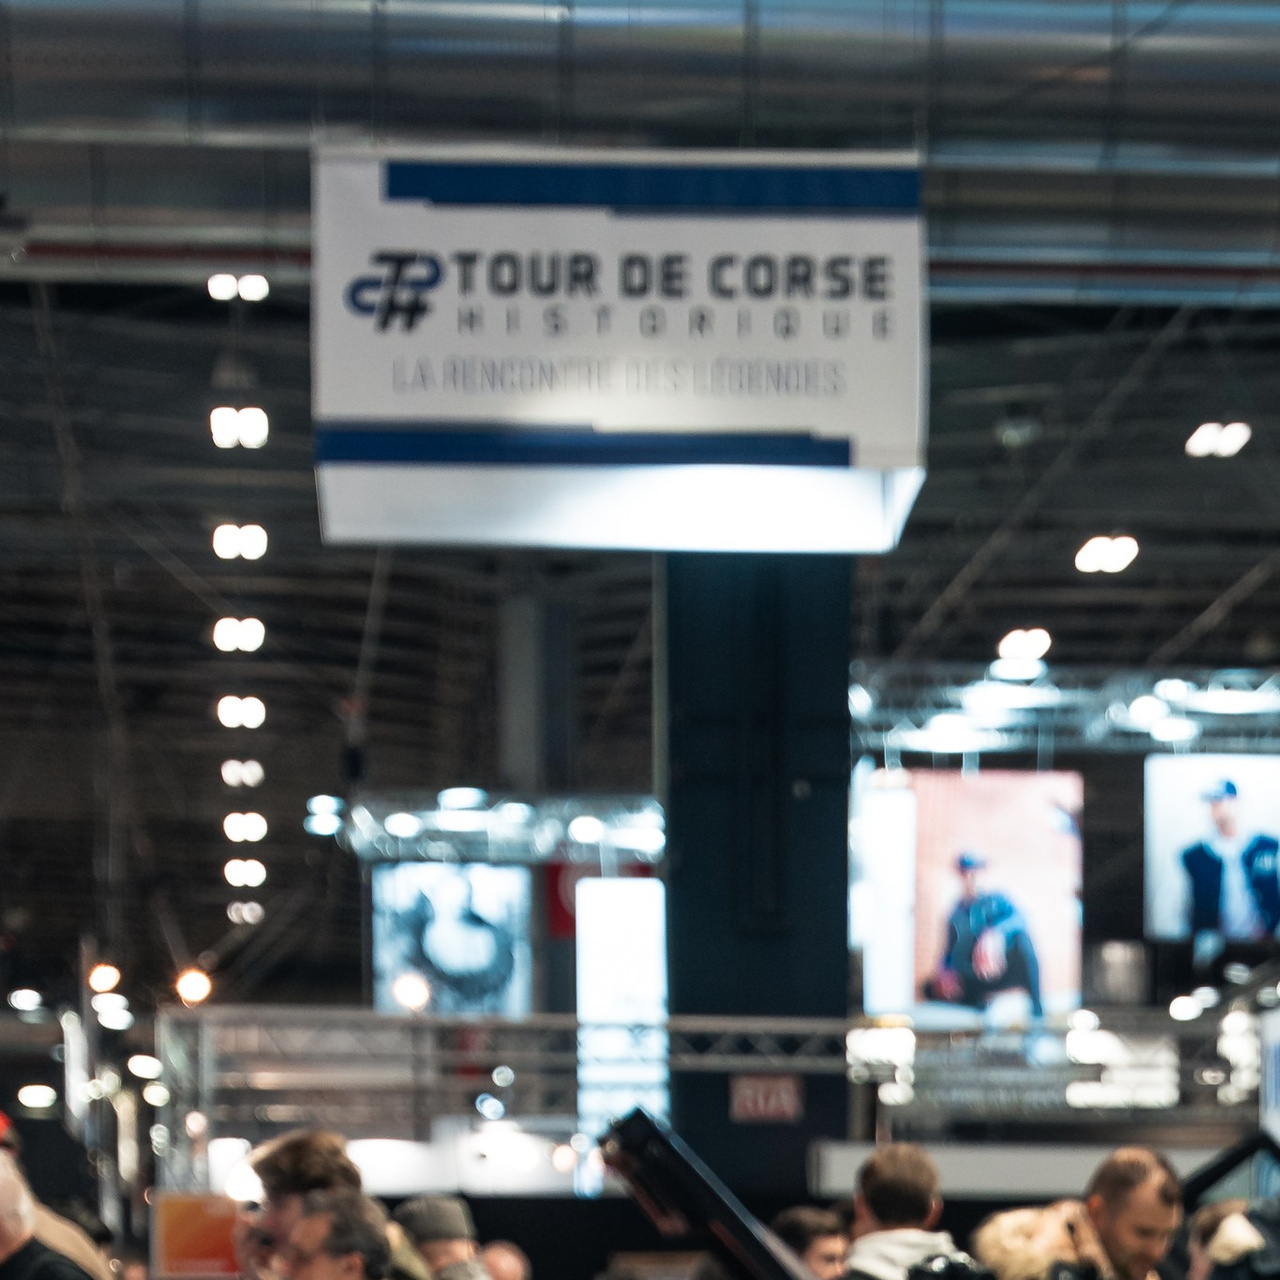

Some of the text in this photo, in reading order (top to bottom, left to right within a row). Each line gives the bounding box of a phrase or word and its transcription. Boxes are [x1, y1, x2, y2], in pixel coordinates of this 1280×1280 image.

[453, 252, 601, 299] TOUR
[617, 252, 690, 300] DE
[706, 252, 891, 301] CORSE
[456, 303, 895, 338] HISTORIQUE
